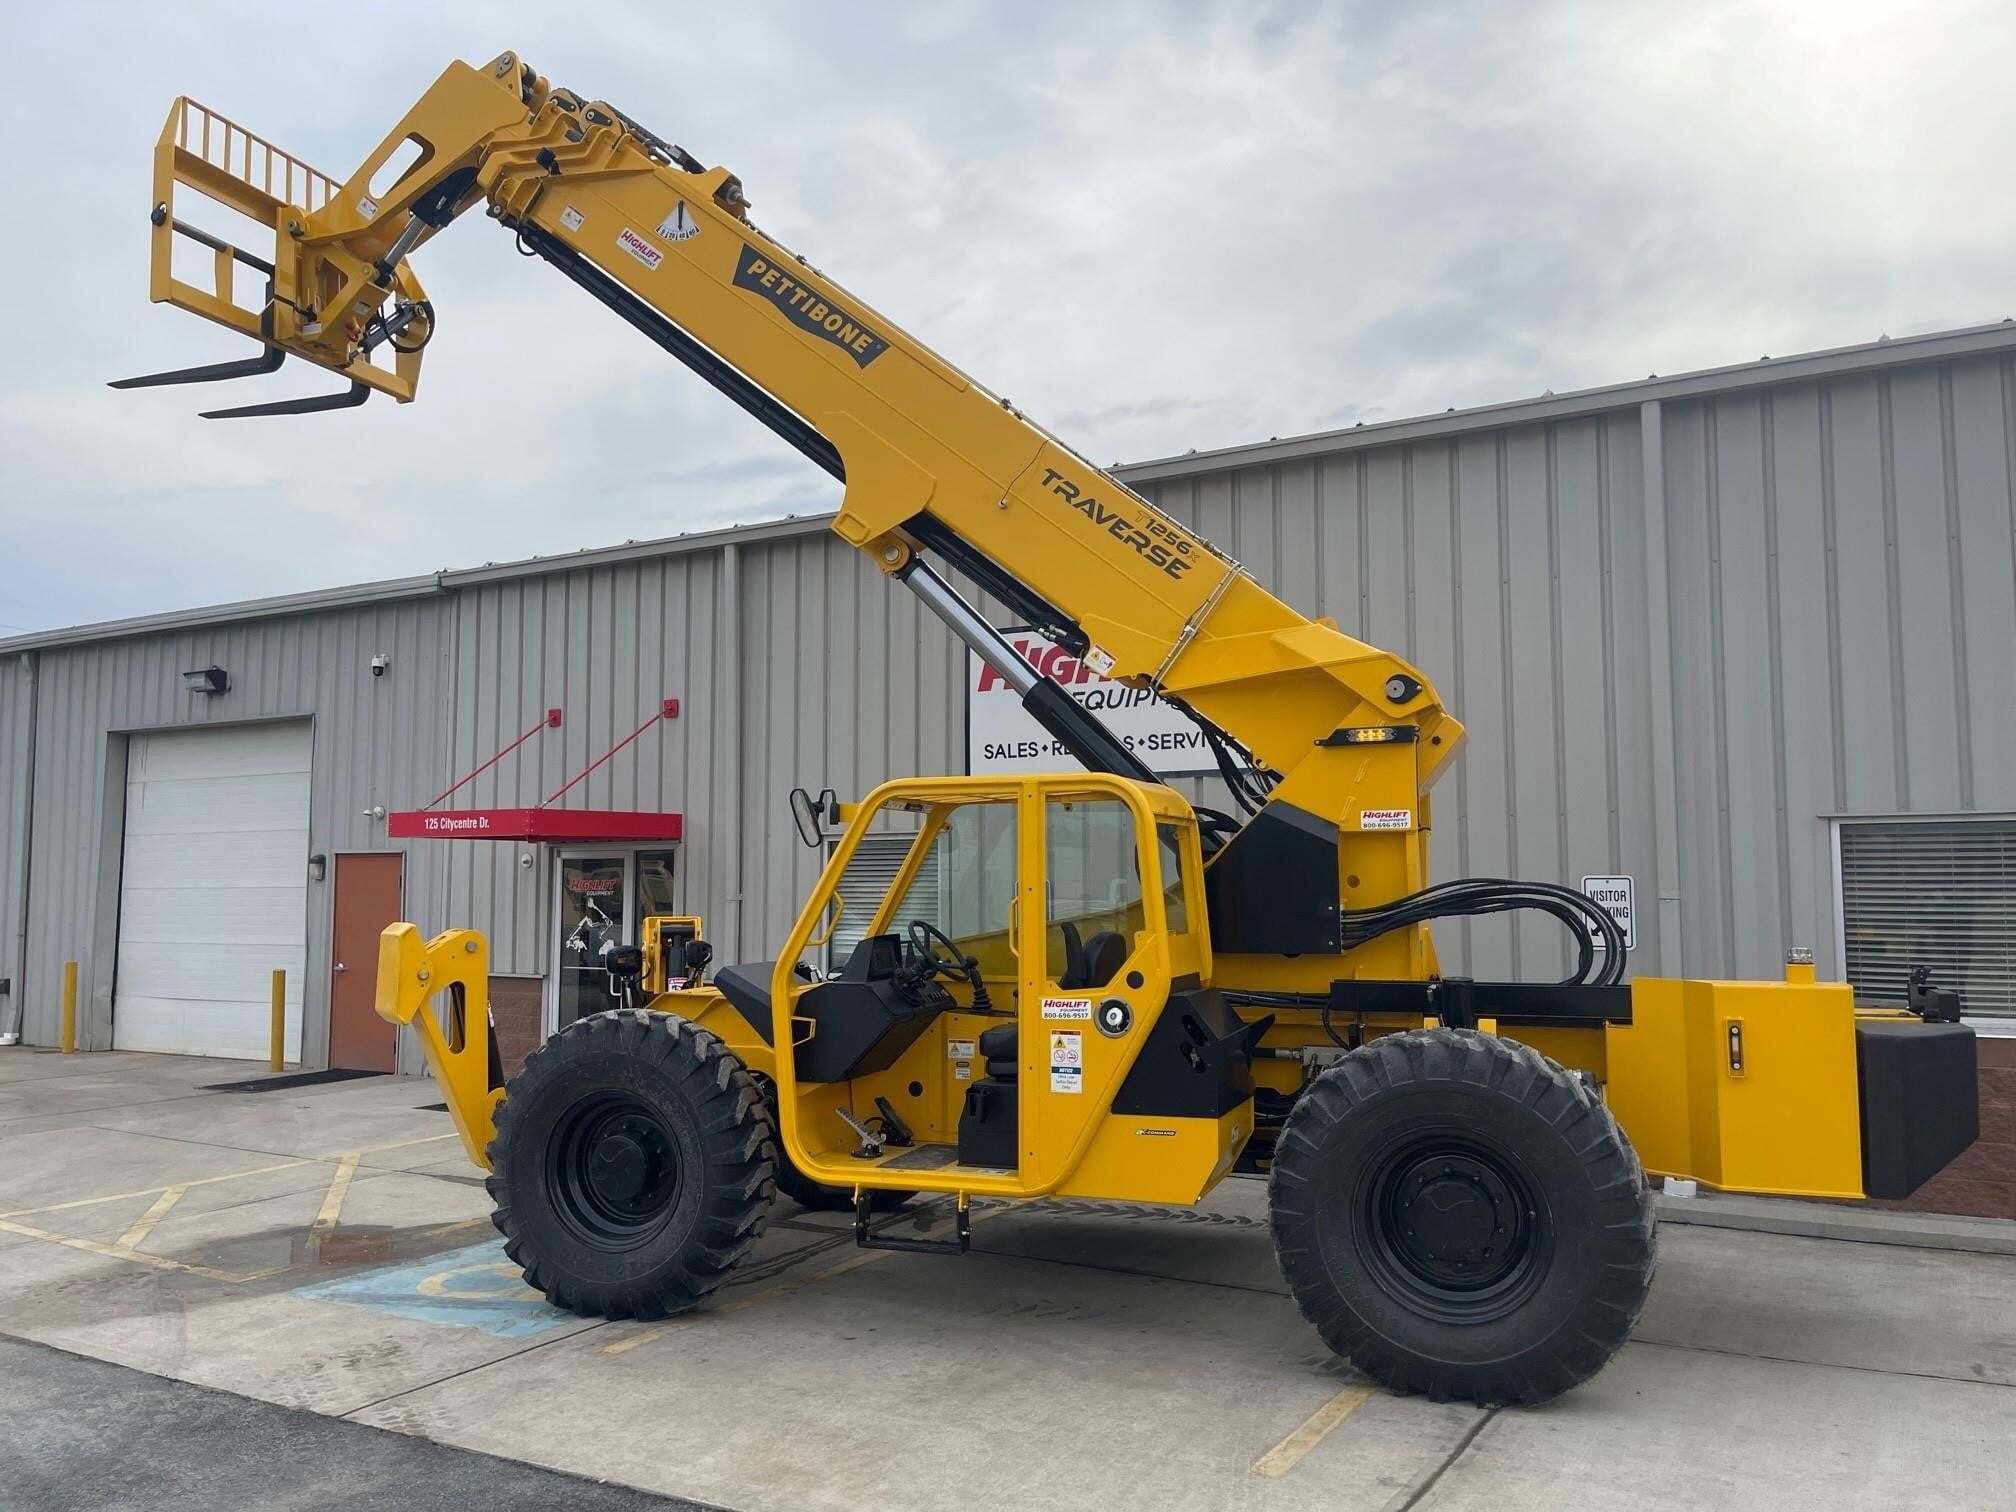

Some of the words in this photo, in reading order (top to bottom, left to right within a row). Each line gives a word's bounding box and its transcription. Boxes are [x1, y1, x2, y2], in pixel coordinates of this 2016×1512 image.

[621, 230, 662, 263] HIGHLIFT
[745, 258, 873, 355] PETTIBONE
[1039, 467, 1192, 580] TRAVERSE
[983, 741, 1039, 760] SALES
[1148, 731, 1206, 751] SERVI
[1363, 811, 1409, 819] HIGHLIFT
[425, 817, 439, 830] 125
[440, 816, 478, 832] Citycentre
[479, 816, 490, 829] Dr.
[1589, 890, 1627, 902] VISITOR
[1607, 906, 1630, 918] KING
[1043, 999, 1089, 1008] HIGHLIFT
